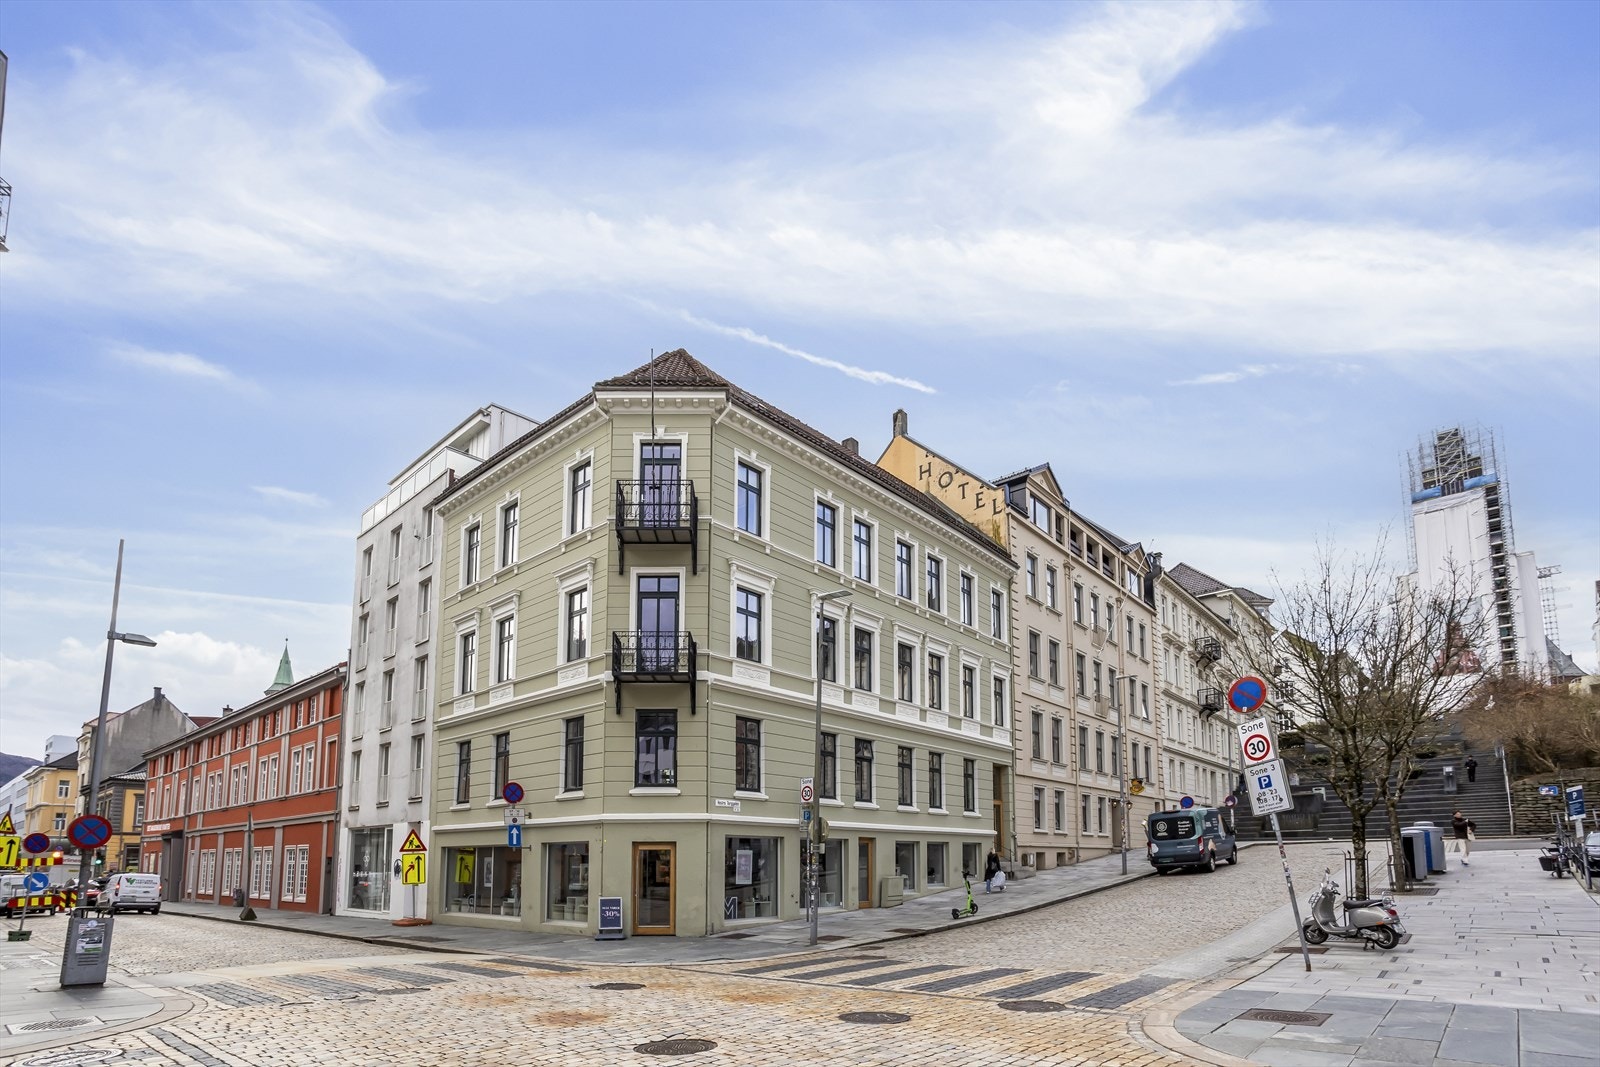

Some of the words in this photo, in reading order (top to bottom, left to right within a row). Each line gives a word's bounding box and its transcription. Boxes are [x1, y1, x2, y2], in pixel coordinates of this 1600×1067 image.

[918, 461, 1003, 516] HOTEL
[1241, 721, 1264, 735] Sone
[1248, 740, 1266, 756] 30
[1249, 766, 1268, 777] Sone
[803, 790, 810, 798] 30
